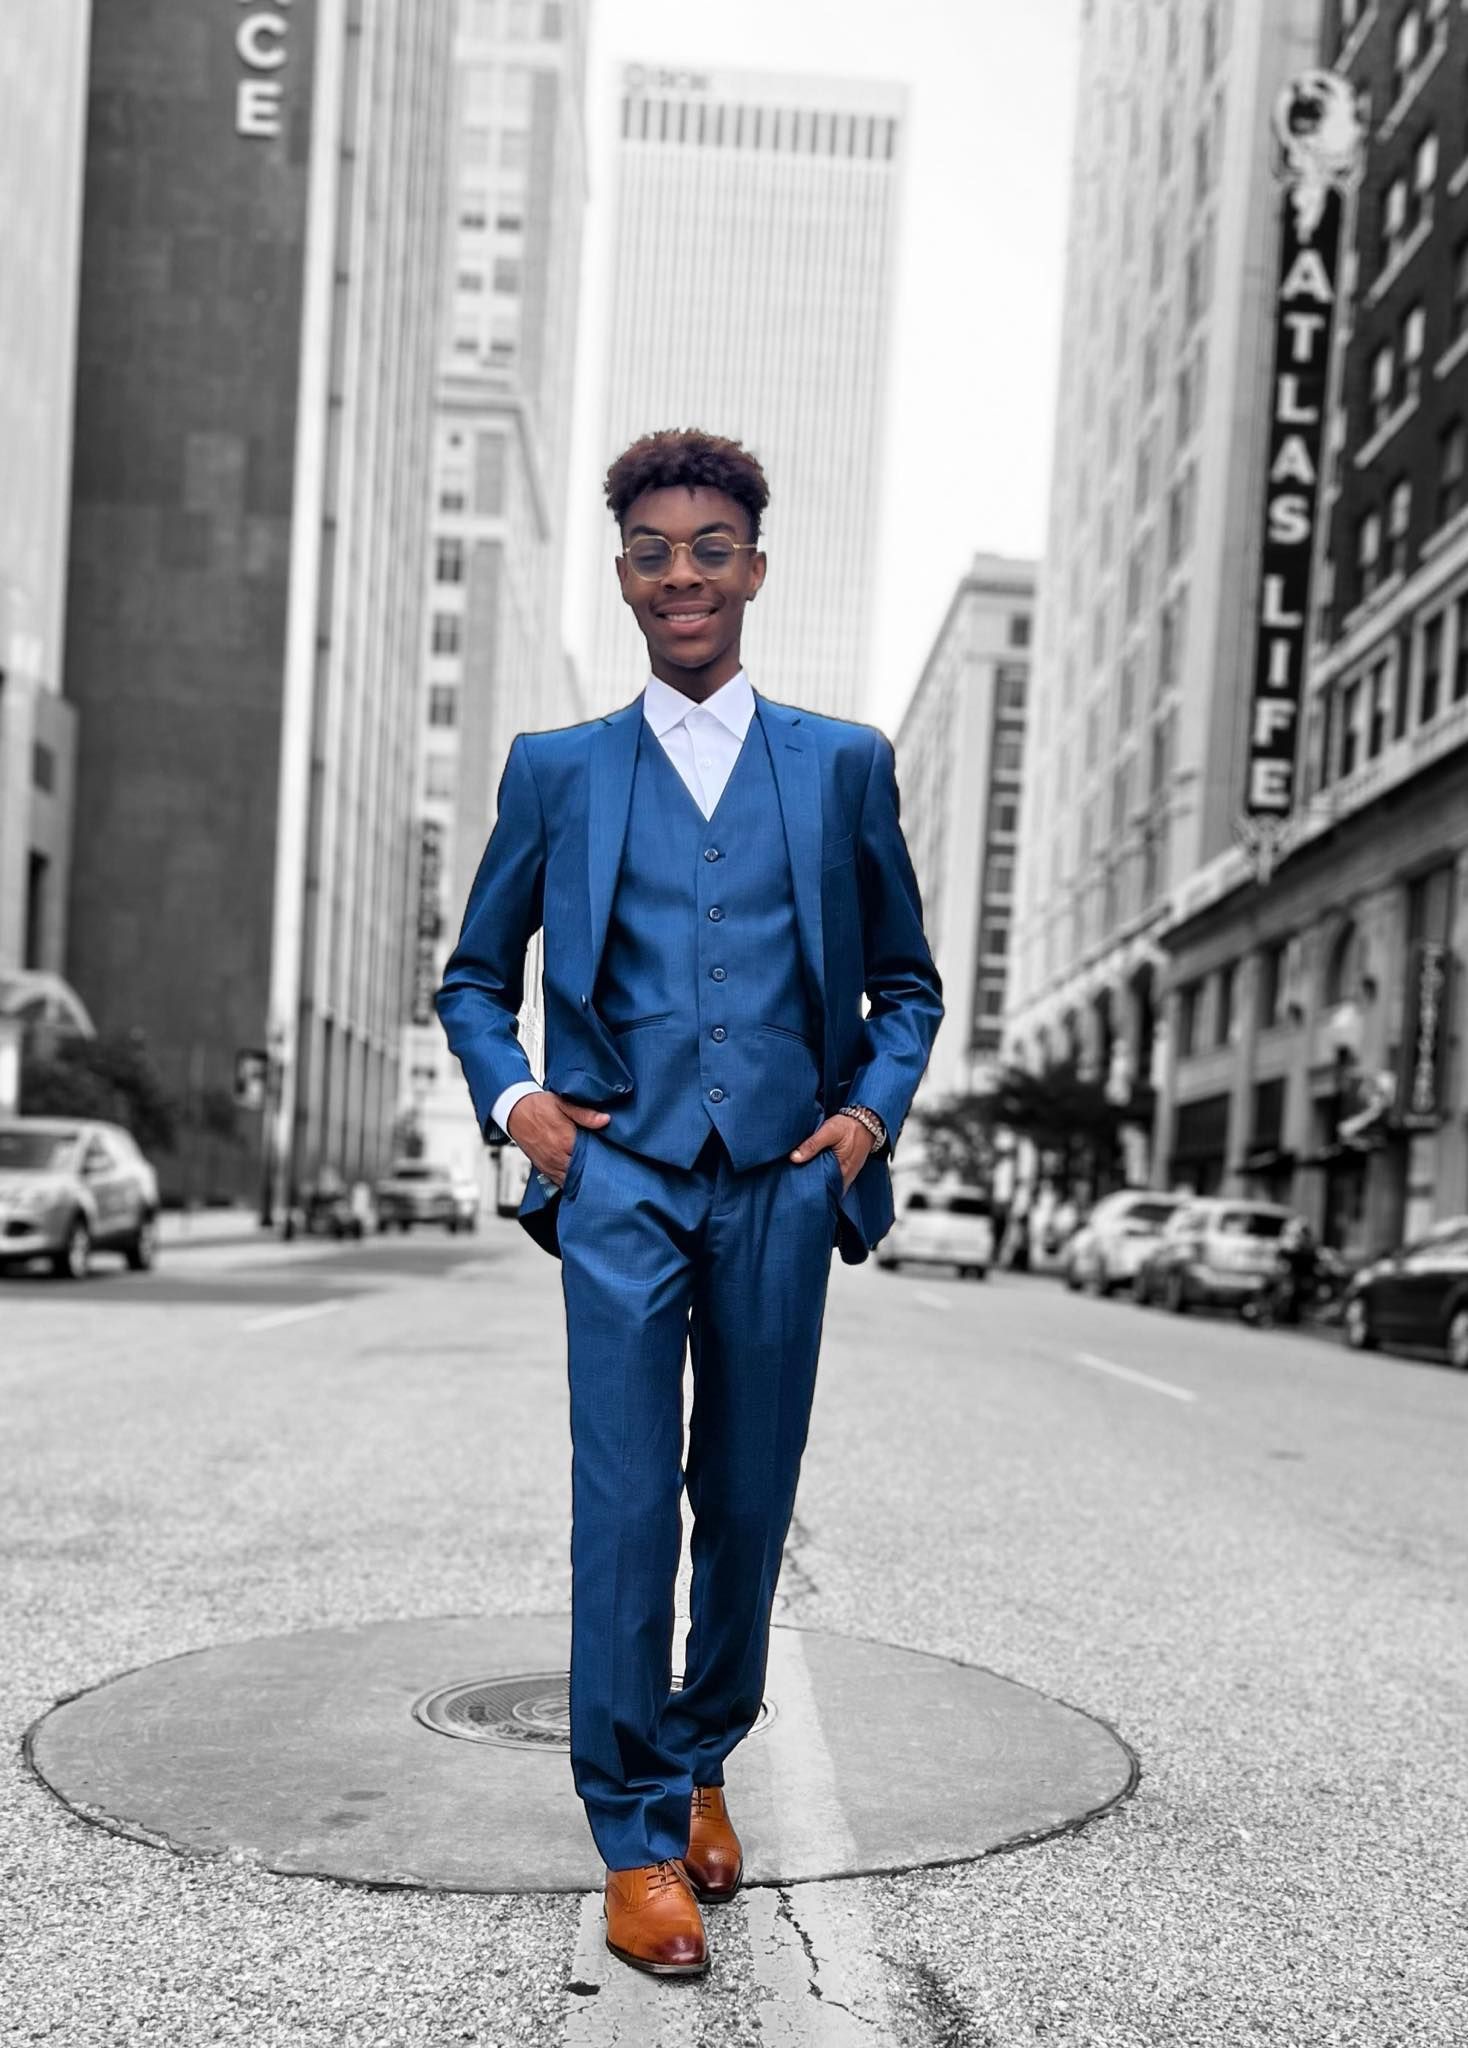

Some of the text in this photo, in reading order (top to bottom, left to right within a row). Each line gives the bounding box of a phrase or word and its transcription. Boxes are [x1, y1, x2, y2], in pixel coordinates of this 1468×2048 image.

[236, 0, 288, 134] CE
[1250, 248, 1333, 809] ATLAS LIFE
